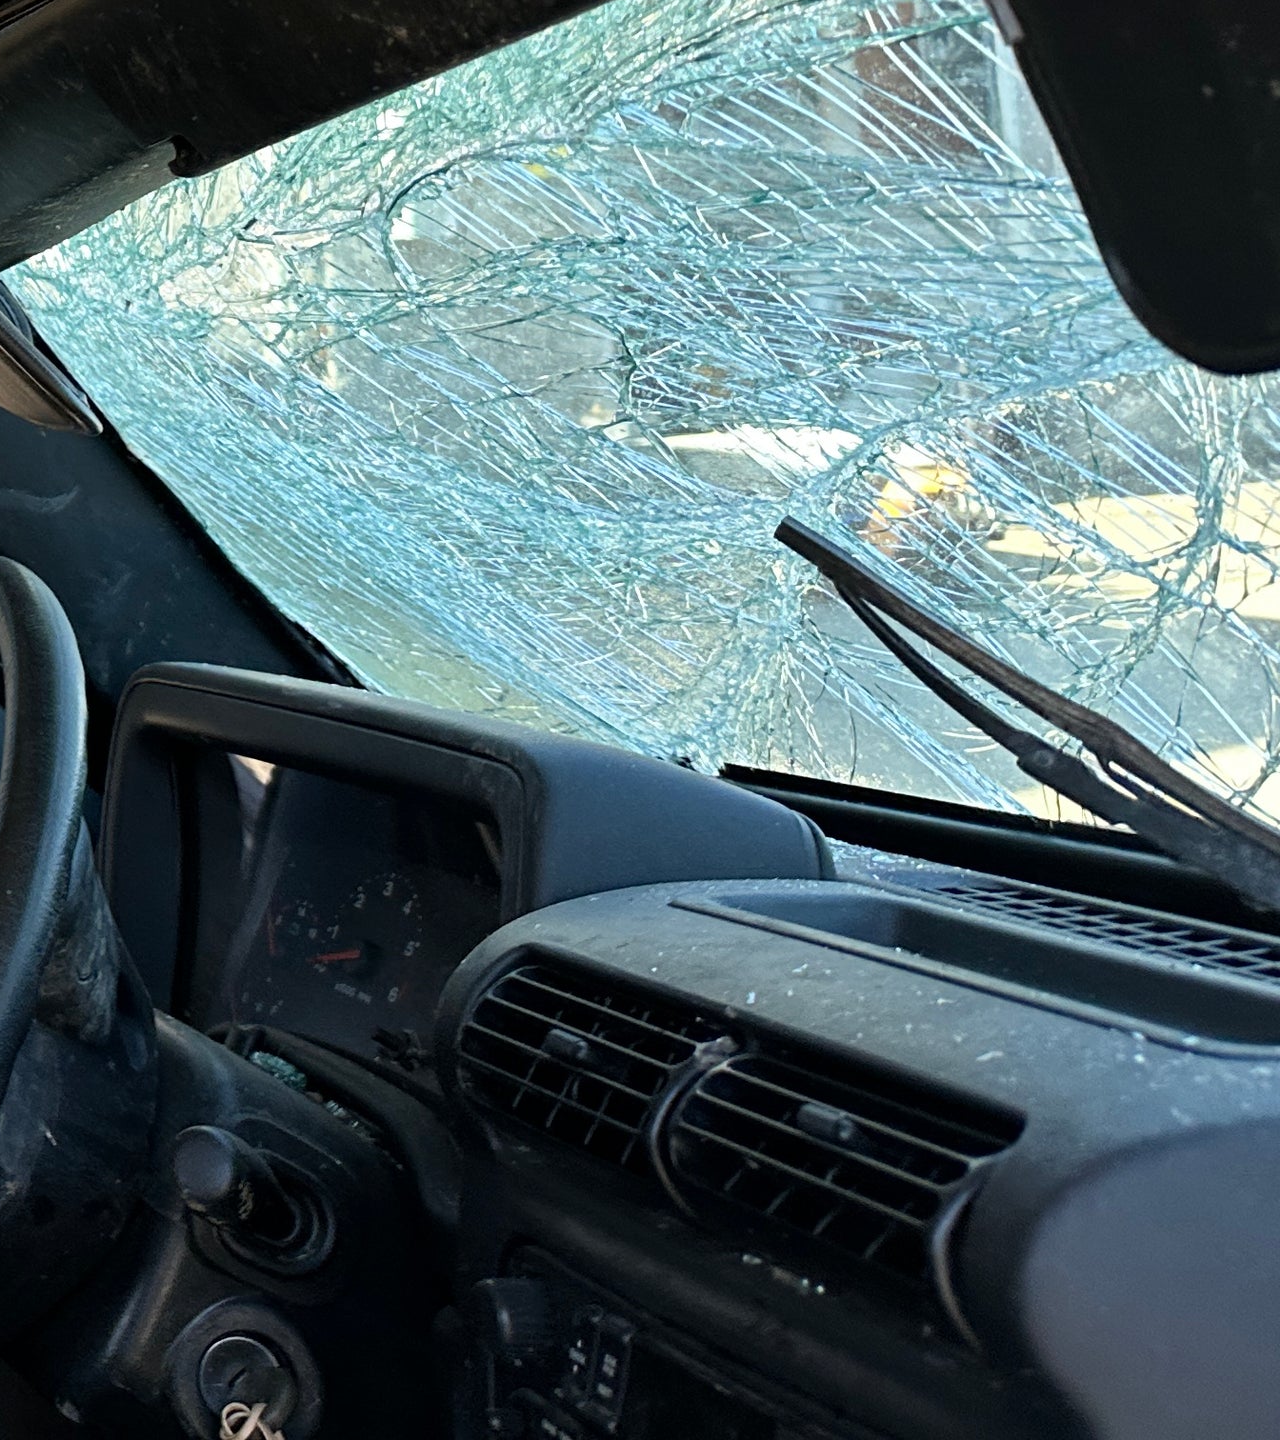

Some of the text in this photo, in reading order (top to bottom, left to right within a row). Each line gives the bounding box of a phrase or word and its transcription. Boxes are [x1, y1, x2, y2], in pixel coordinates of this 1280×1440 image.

[382, 881, 394, 896] 3
[352, 893, 365, 908] 2
[403, 941, 415, 957] 5
[387, 987, 399, 1003] 6
